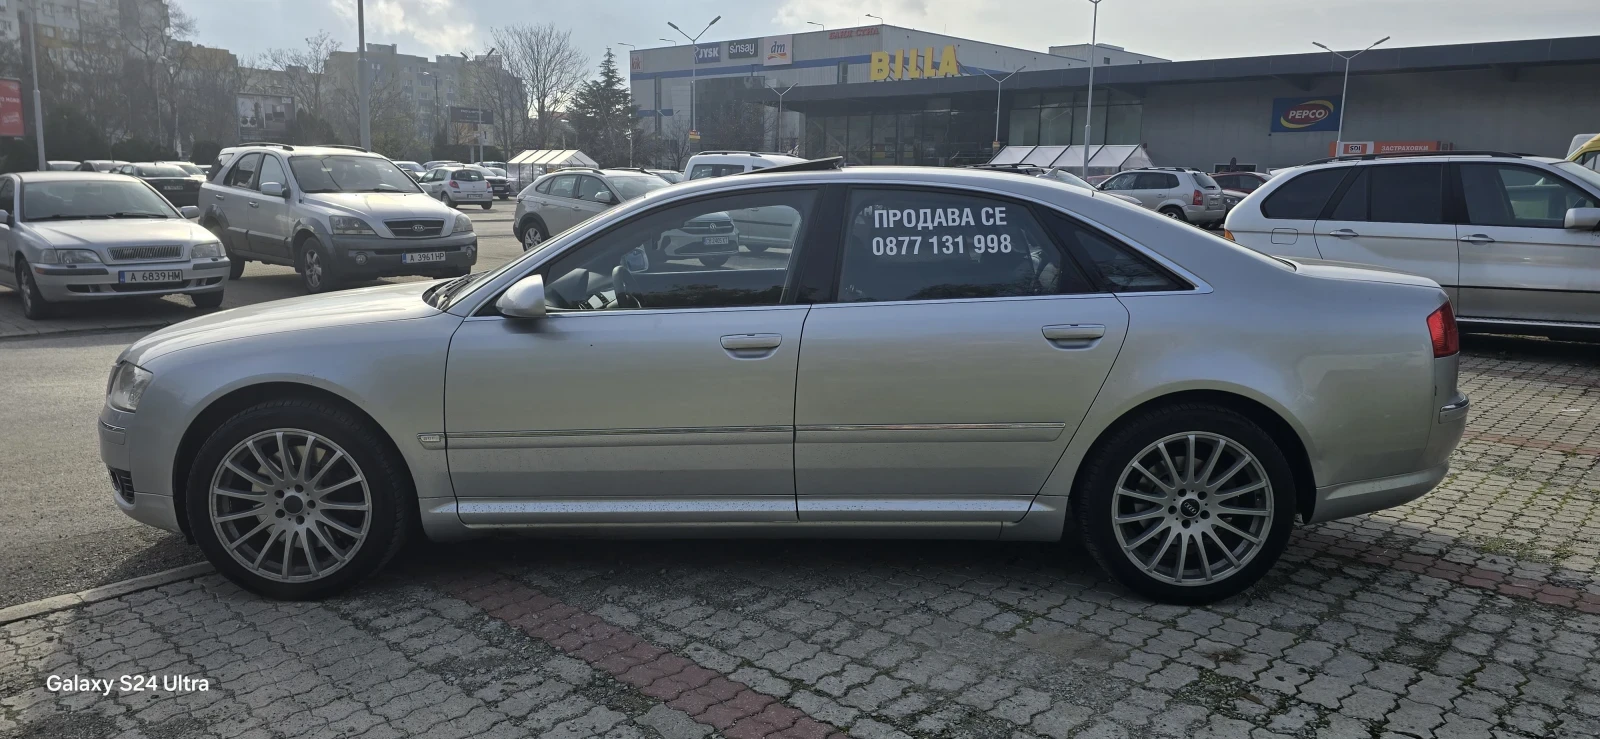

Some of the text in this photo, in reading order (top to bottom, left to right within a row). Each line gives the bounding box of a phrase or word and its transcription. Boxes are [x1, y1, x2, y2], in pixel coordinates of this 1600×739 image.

[699, 47, 719, 59] JYSK
[729, 43, 755, 55] sinsay
[771, 41, 785, 53] dm
[870, 44, 960, 80] BILLA
[1288, 109, 1326, 119] PEPCO
[874, 207, 1007, 230] ПРОДАВА СЕ
[872, 234, 1012, 255] 0877 131 998
[410, 254, 415, 262] A
[417, 253, 434, 262] 3961
[130, 271, 180, 281] A 6839 HM
